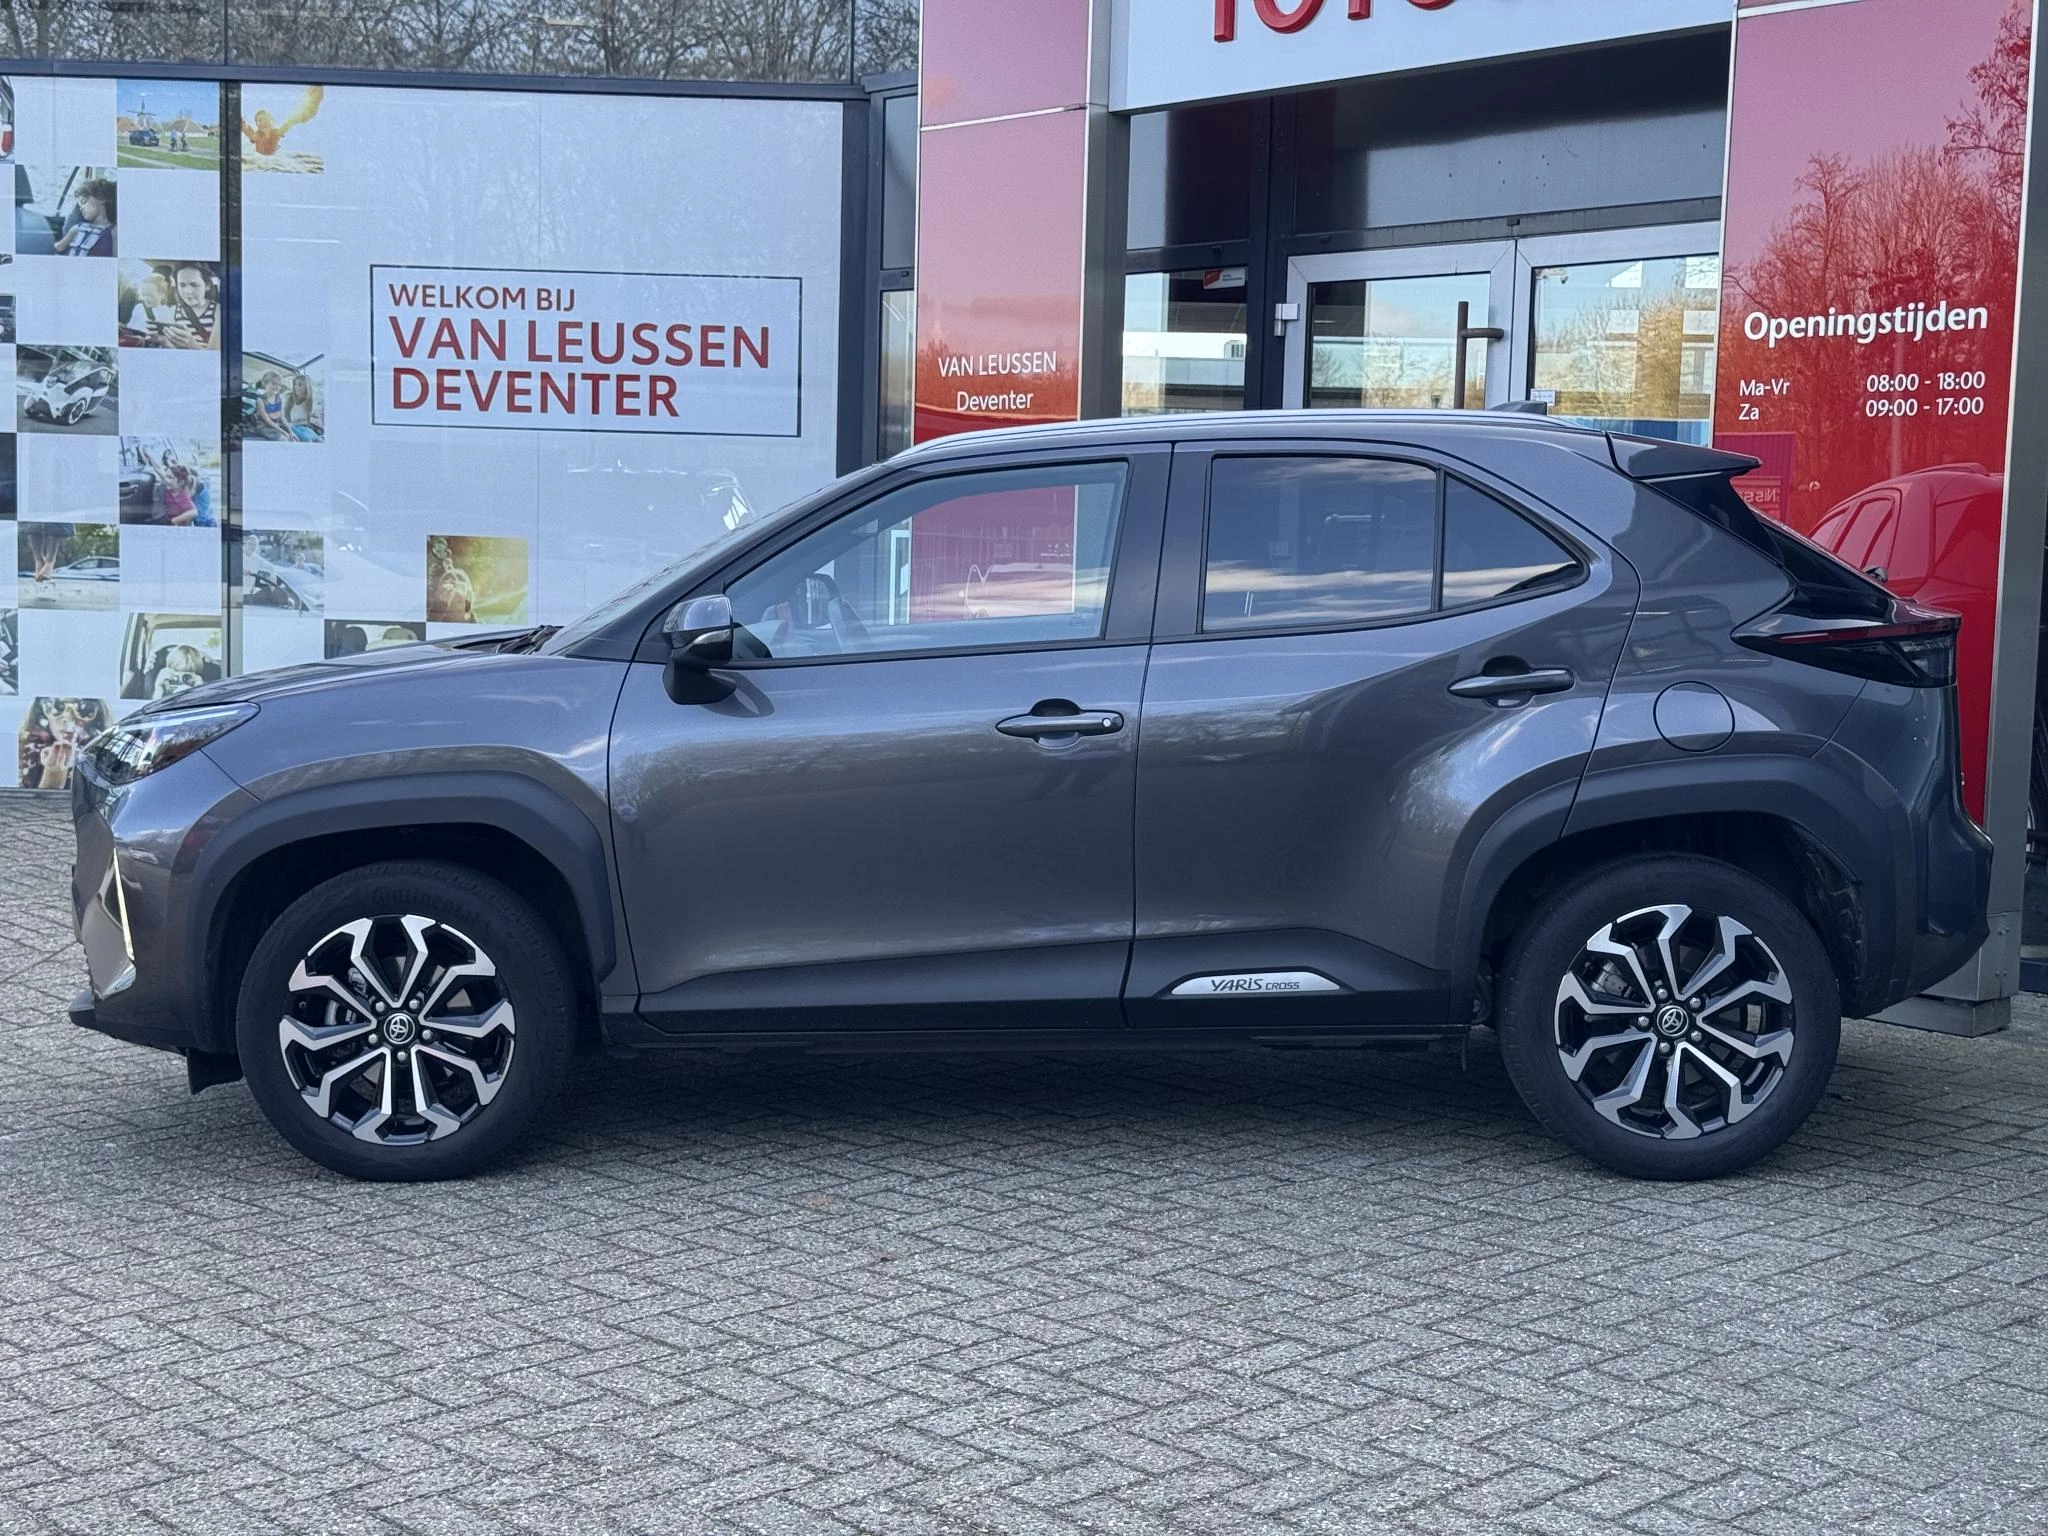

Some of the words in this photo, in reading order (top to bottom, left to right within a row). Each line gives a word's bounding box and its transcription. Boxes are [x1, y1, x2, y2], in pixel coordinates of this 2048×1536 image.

[388, 283, 527, 311] WELKOM
[535, 288, 577, 312] BIJ
[1744, 301, 1989, 348] Openingstijden
[388, 315, 507, 361] VAN
[527, 319, 770, 369] LEUSSEN
[938, 355, 974, 377] VAN
[979, 350, 1057, 376] LEUSSEN
[392, 367, 681, 418] DEVENTER
[1739, 378, 1790, 397] Ma-Vr
[1866, 373, 1919, 393] 08:00
[1937, 371, 1986, 390] 18:00
[956, 390, 1034, 411] Deventer
[1865, 399, 1918, 417] 09:00
[1936, 397, 1984, 416] 17:00
[1738, 403, 1760, 421] Za
[1265, 981, 1300, 990] CROSS
